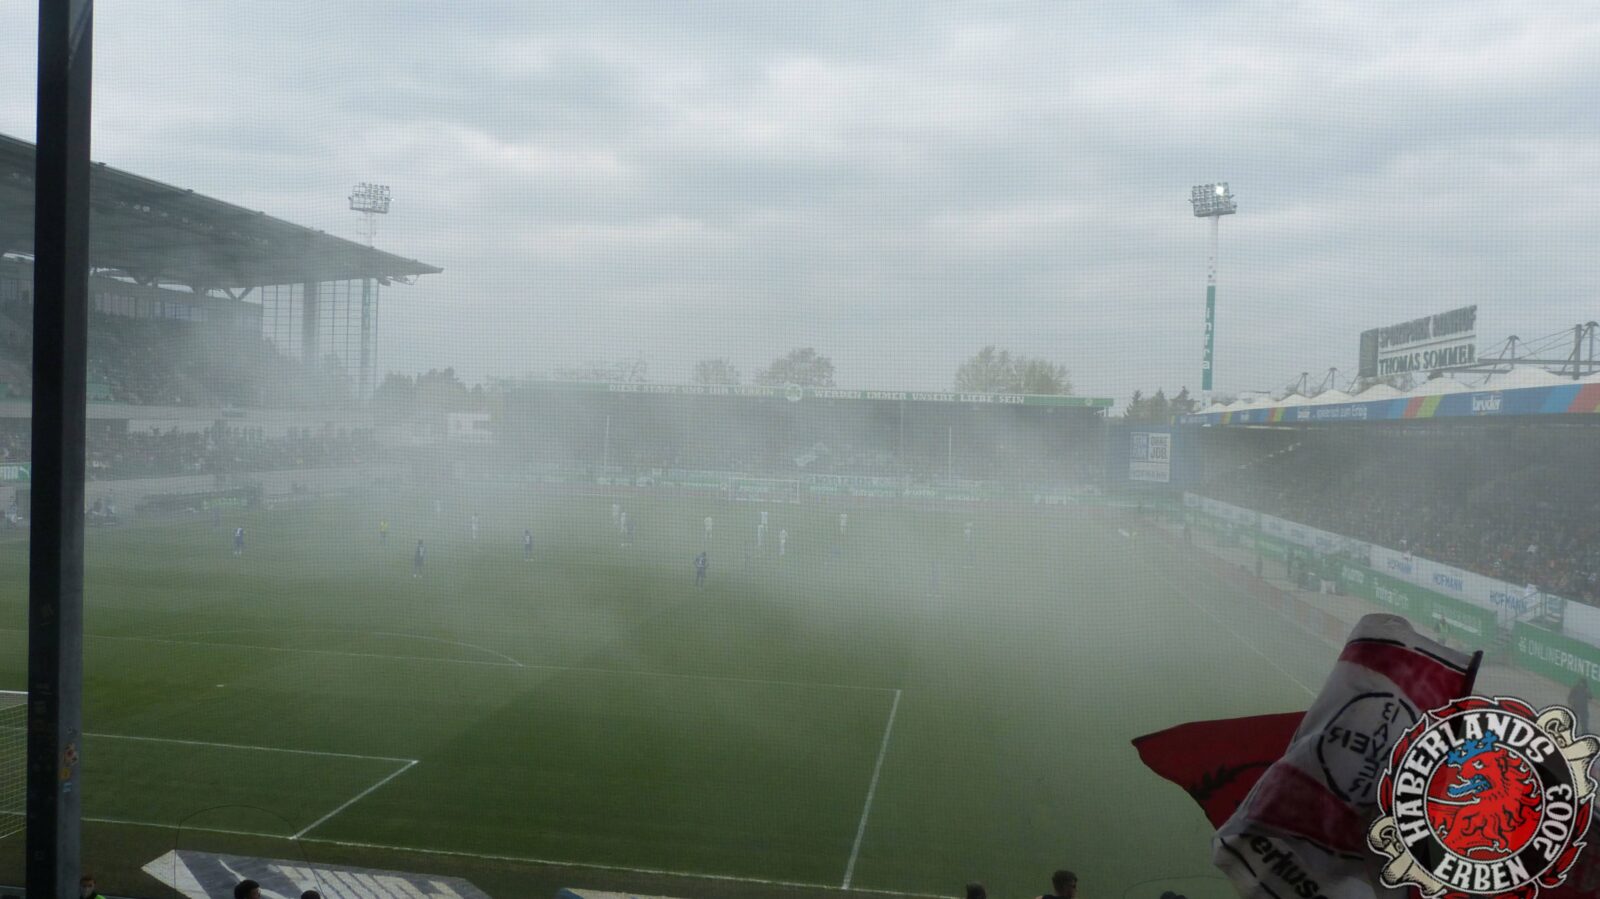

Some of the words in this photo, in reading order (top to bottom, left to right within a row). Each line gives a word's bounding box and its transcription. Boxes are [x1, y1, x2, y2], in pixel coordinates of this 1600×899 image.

[1379, 353, 1420, 375] THOMAS
[1423, 343, 1476, 369] SOMMER
[866, 391, 907, 400] IMMER
[960, 394, 993, 402] LIEBE
[999, 396, 1025, 404] SEIN
[1433, 572, 1463, 592] HOFMANN
[1528, 639, 1600, 682] ONLINEPRINTE
[1249, 834, 1329, 899] erkus
